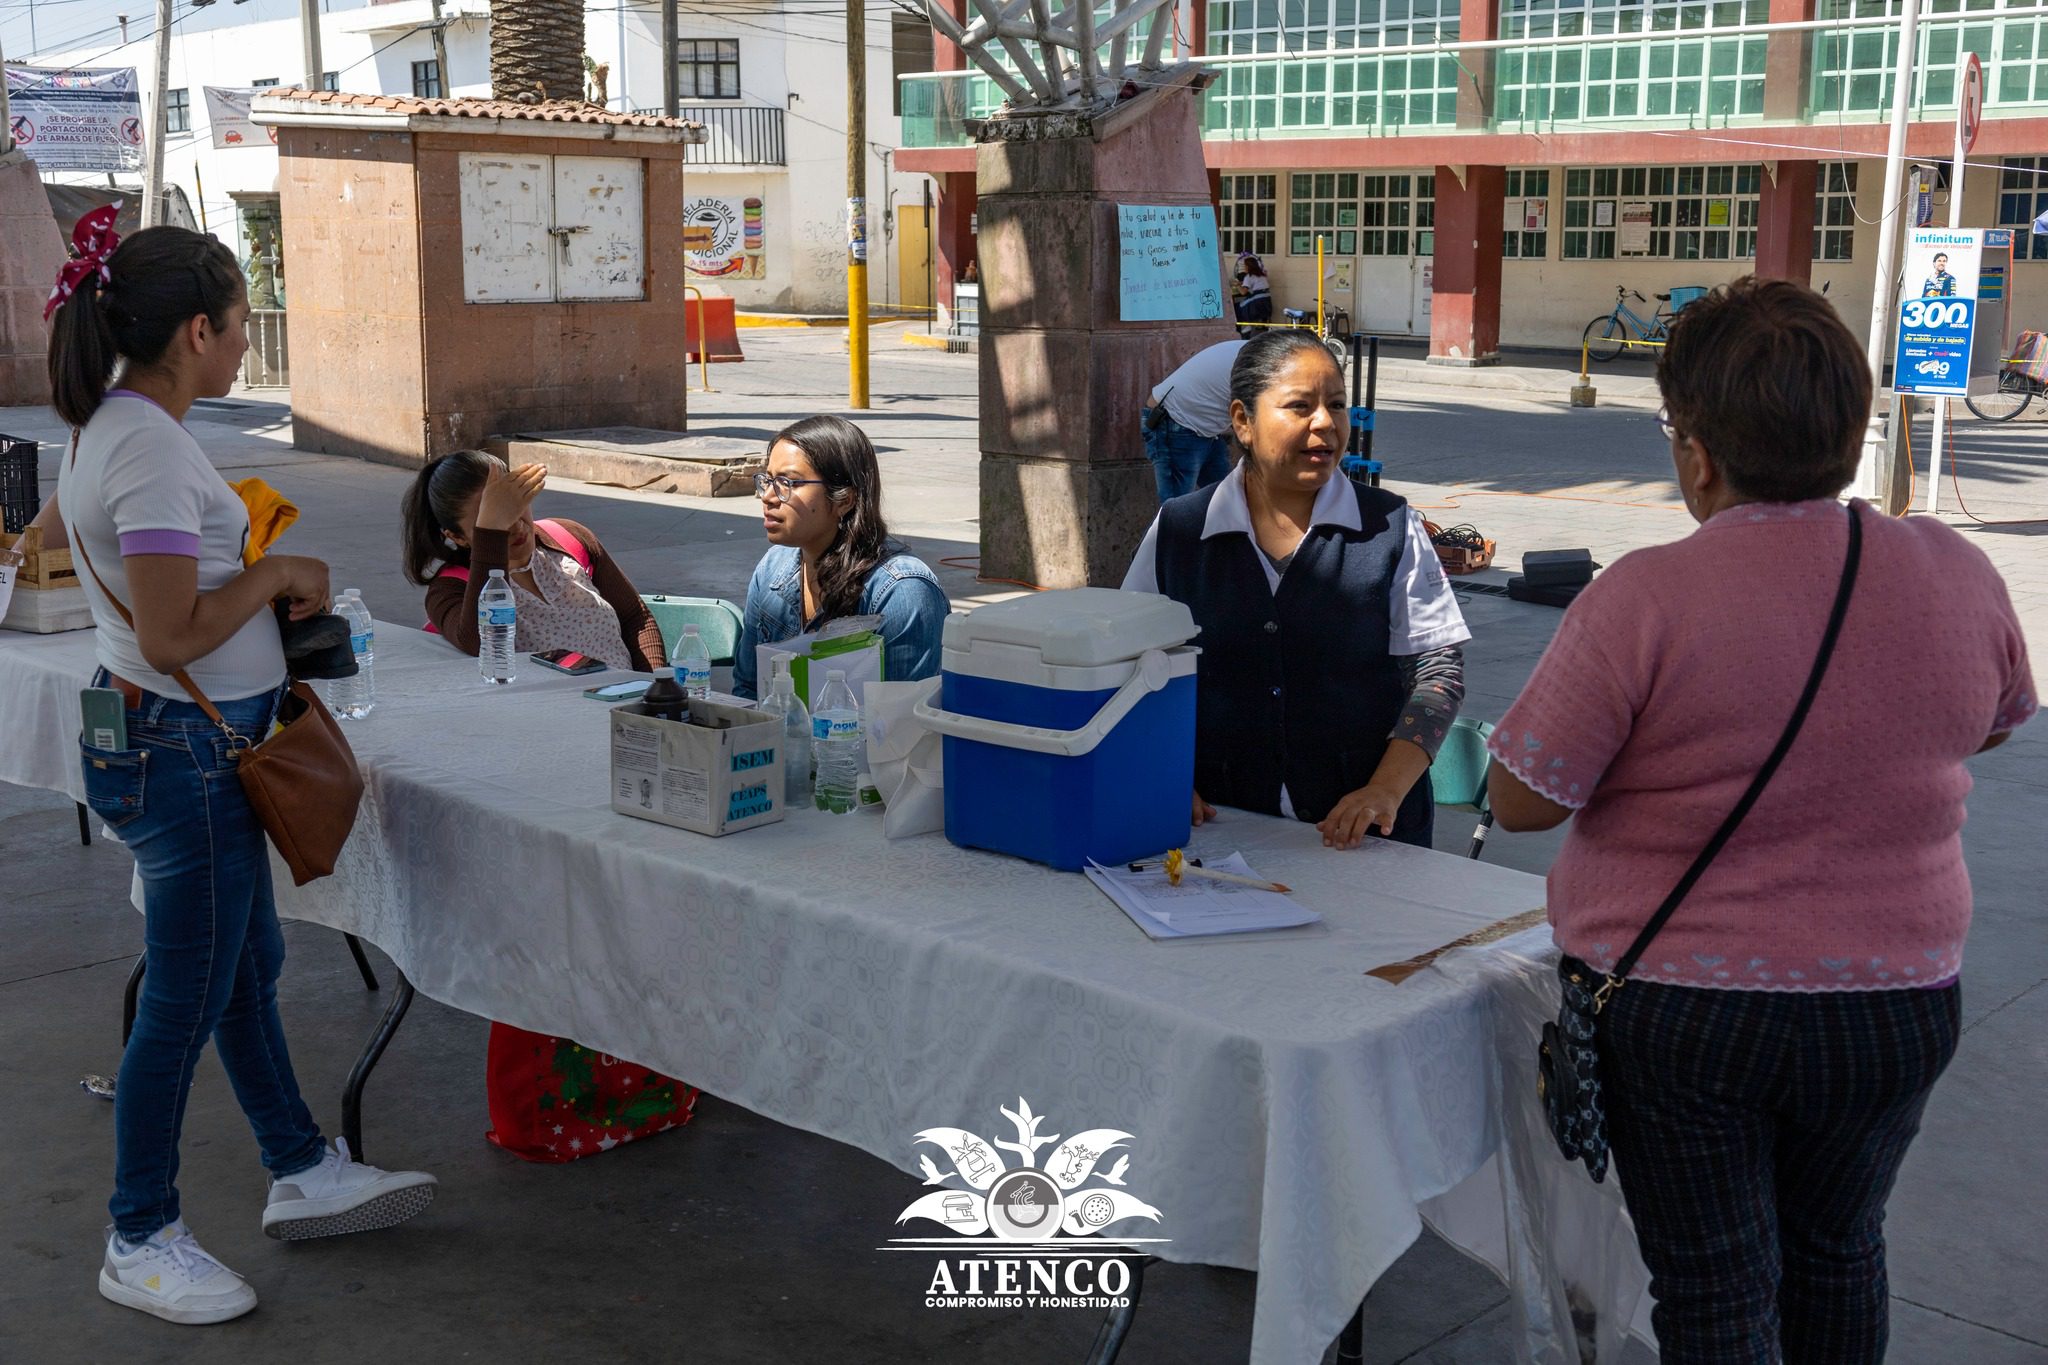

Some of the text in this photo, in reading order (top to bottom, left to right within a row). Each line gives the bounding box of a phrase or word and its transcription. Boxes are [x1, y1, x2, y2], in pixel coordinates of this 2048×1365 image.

[684, 198, 736, 224] HELADERIA
[1136, 209, 1156, 222] salud
[1161, 214, 1166, 224] y
[1190, 208, 1200, 220] tu
[1174, 224, 1188, 236] tus
[1915, 234, 1973, 244] infinitum
[1902, 301, 1968, 328] 300
[733, 748, 774, 771] ISEM
[731, 784, 767, 802] CEAPS
[727, 800, 773, 822] ATENCO
